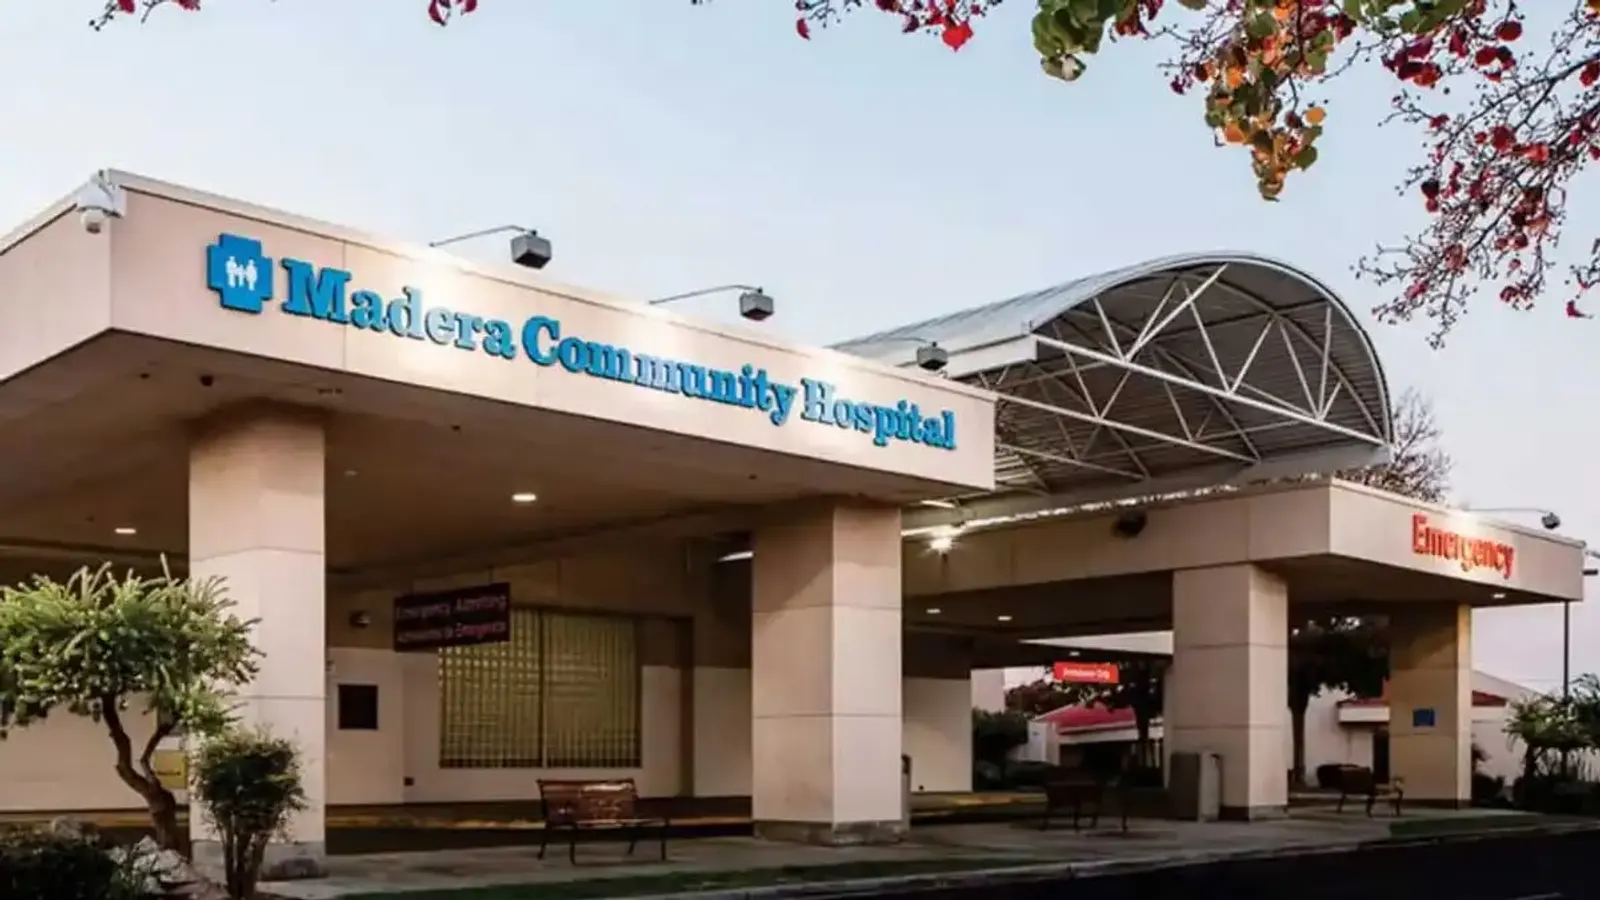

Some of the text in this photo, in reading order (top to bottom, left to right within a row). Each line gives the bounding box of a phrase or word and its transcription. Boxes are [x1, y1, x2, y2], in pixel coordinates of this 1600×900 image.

[280, 257, 957, 450] Madera Community Hospital
[1412, 513, 1514, 579] Emergency
